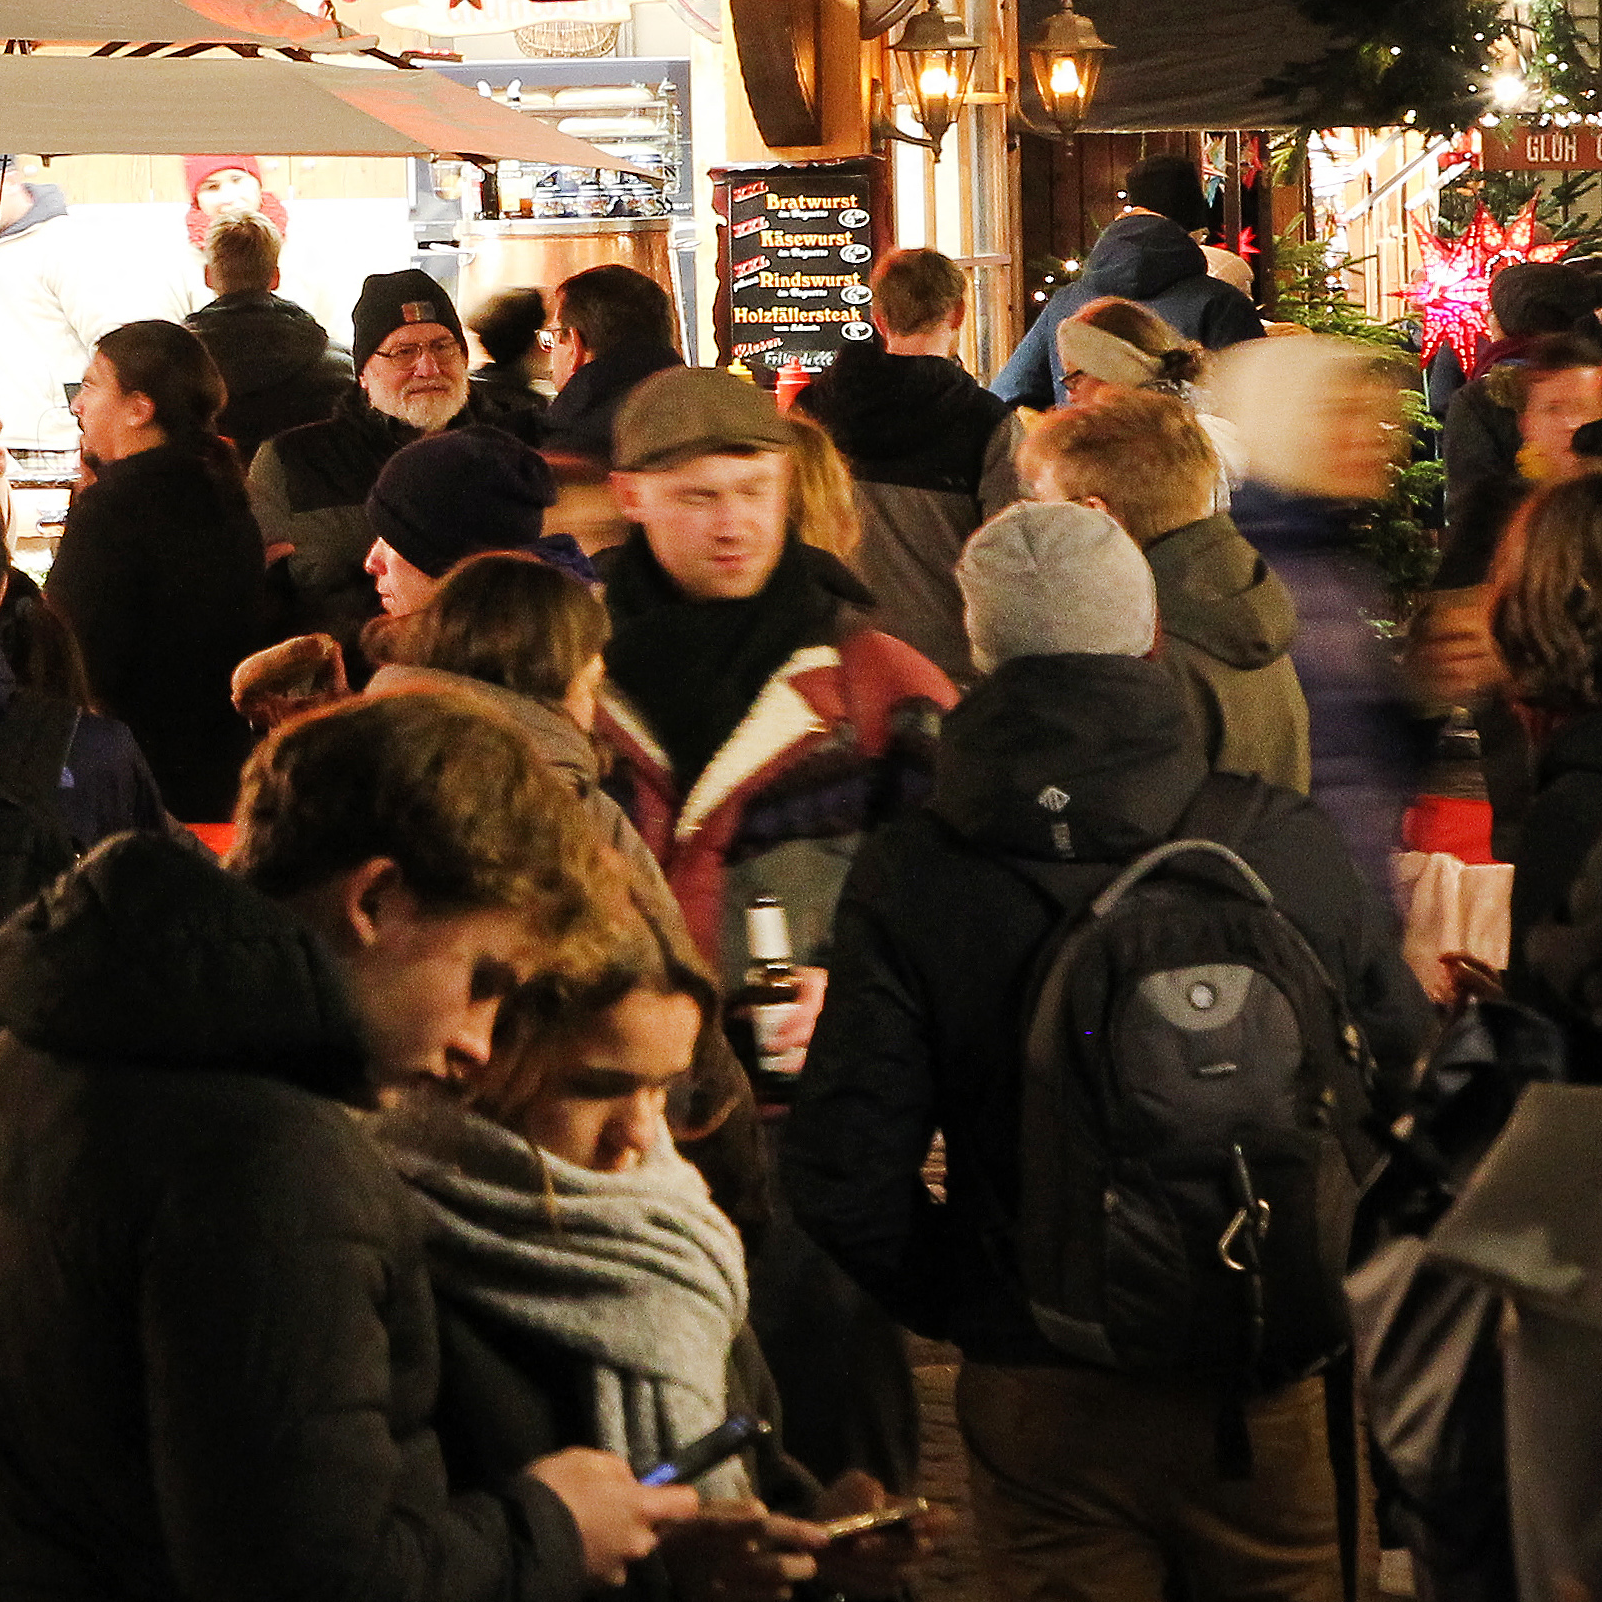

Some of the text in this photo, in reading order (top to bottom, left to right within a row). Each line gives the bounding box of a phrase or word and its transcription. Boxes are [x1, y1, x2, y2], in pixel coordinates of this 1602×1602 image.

[765, 193, 859, 210] Bratwurst
[759, 229, 854, 248] Käsewurst
[758, 270, 862, 288] Rindswurst
[733, 306, 862, 324] Holzfällersteak
